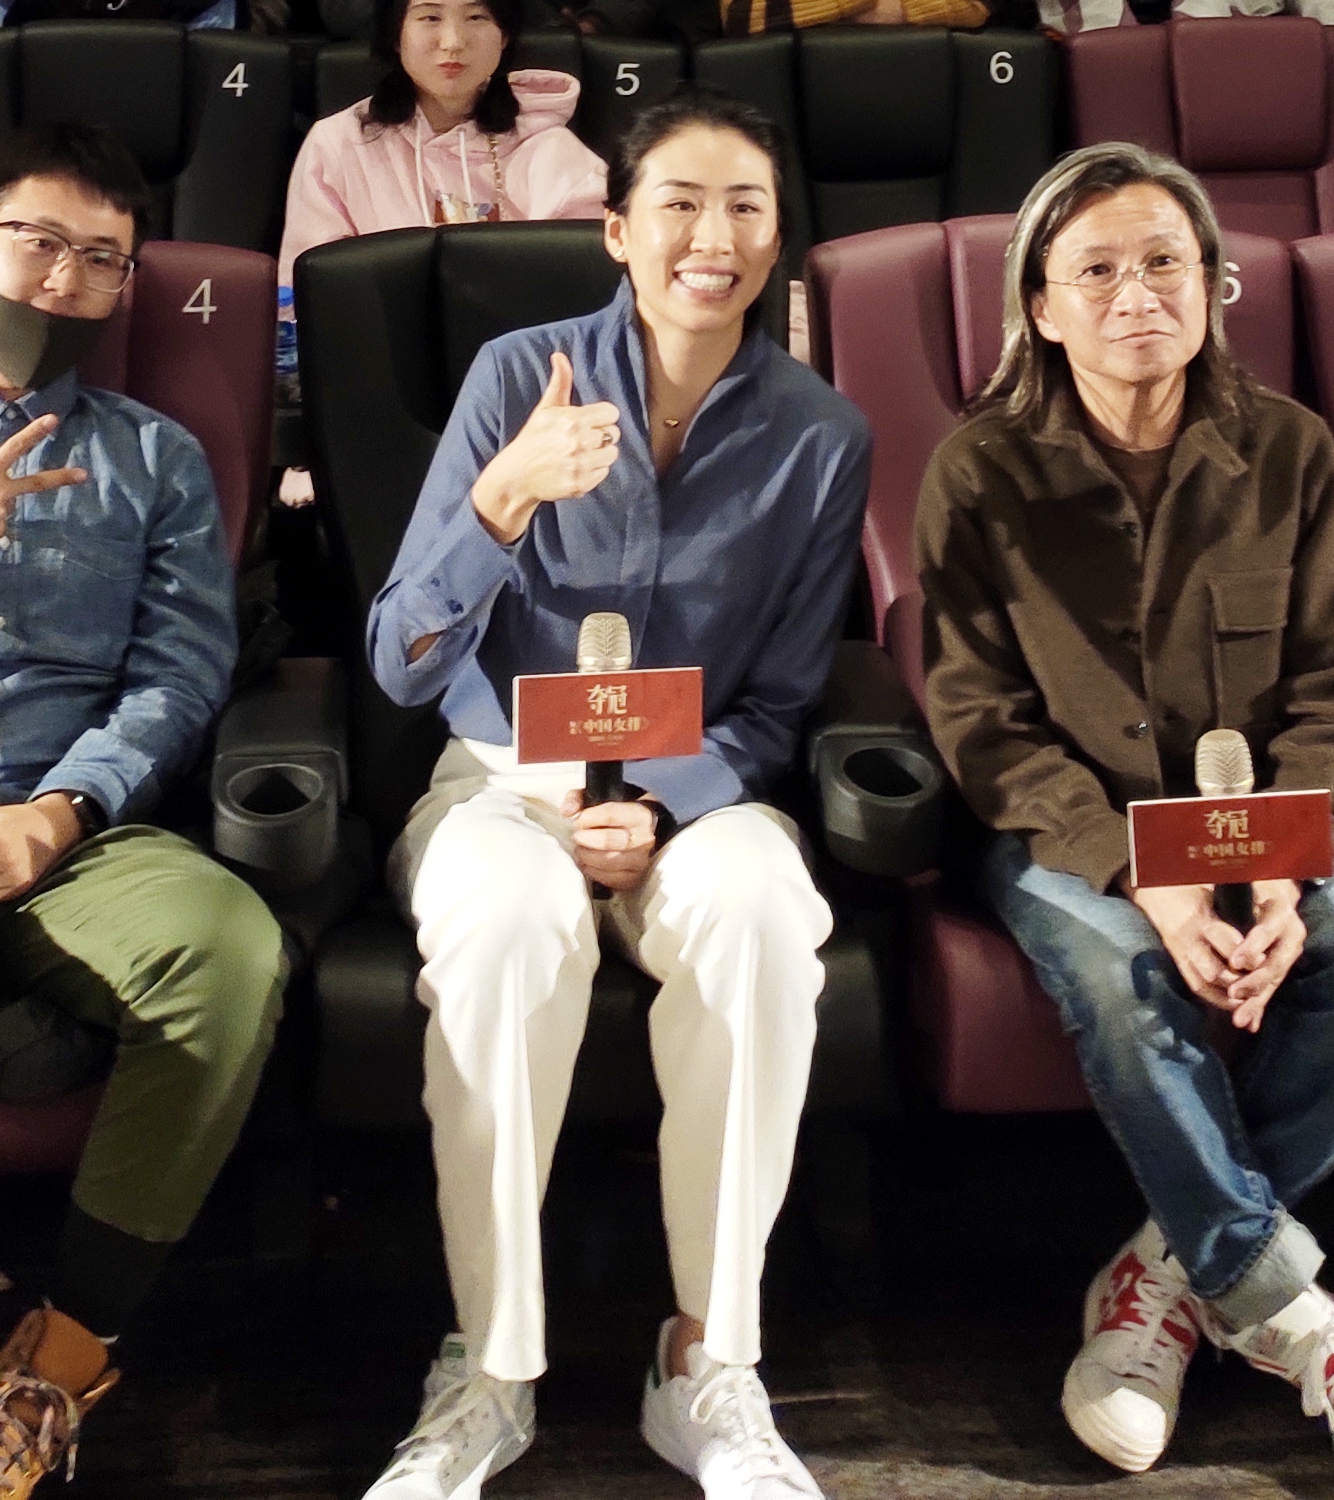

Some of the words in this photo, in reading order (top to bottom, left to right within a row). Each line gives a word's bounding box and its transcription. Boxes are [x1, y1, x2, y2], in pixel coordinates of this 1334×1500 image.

[221, 62, 249, 97] 4
[615, 63, 641, 96] 5
[990, 51, 1015, 84] 6
[1221, 262, 1242, 307] 6
[181, 278, 218, 325] 4
[585, 683, 629, 716] 夺冠
[1202, 809, 1250, 840] 夺冠
